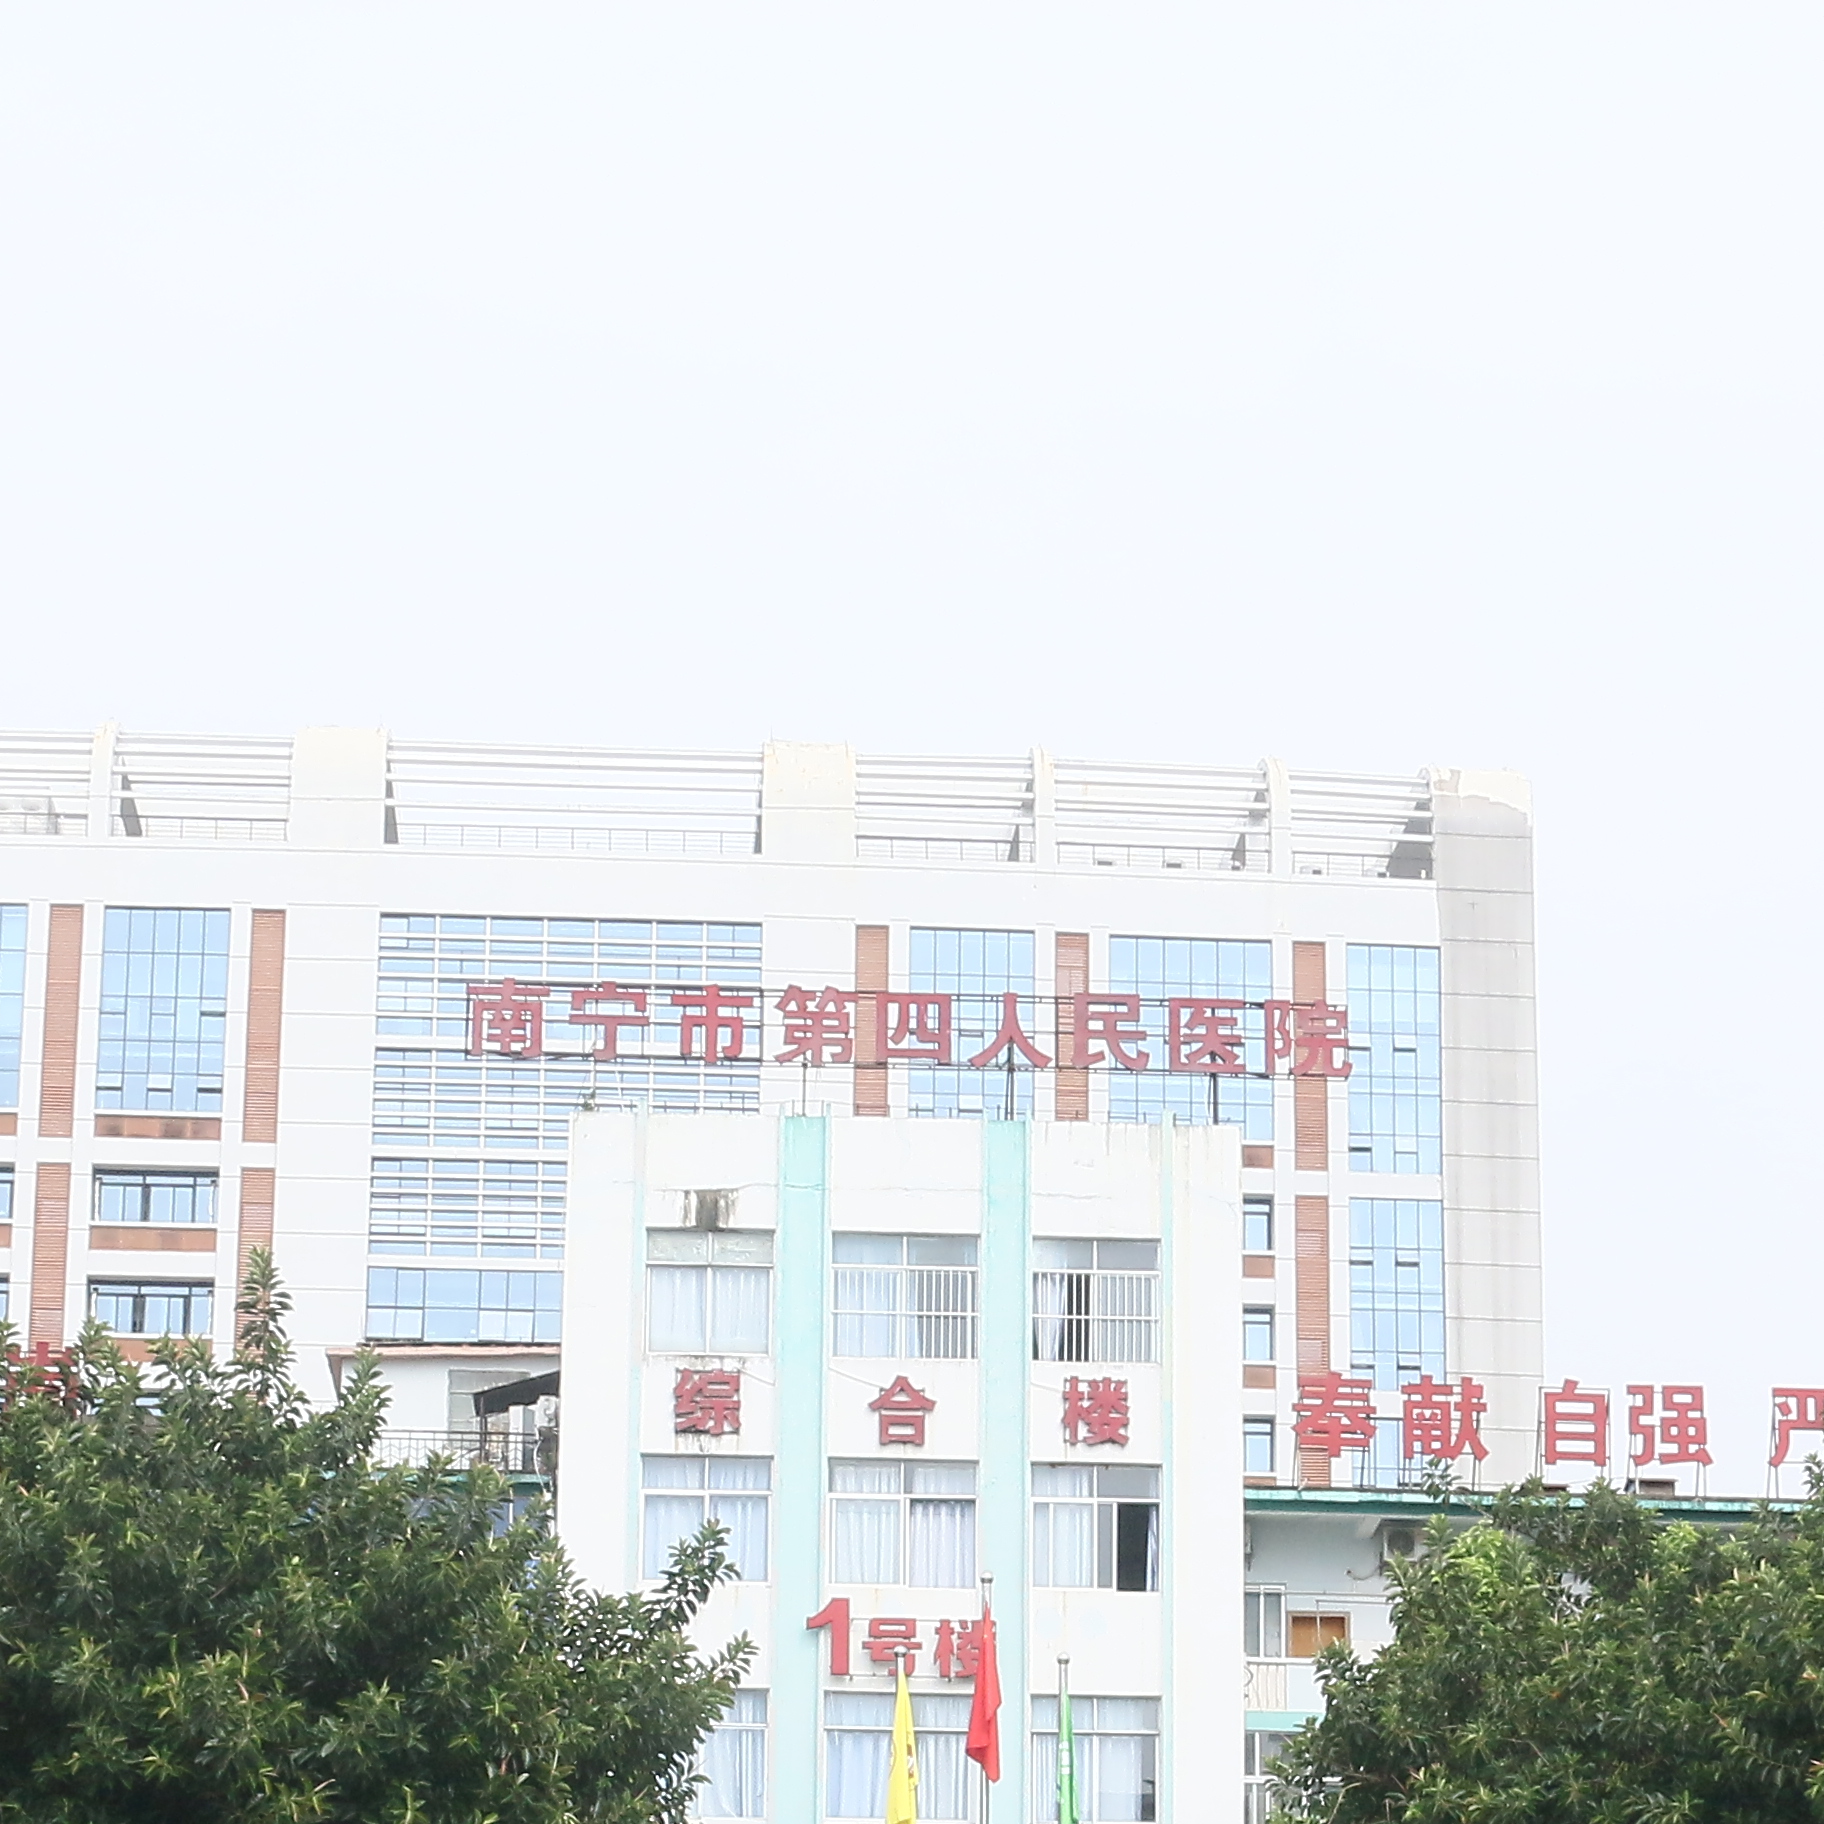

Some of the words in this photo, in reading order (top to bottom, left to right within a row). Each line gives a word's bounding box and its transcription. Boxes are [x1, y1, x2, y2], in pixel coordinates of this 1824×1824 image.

[467, 978, 1353, 1080] 南宁市第四人民医院
[673, 1367, 1131, 1448] 综合楼
[1292, 1372, 1489, 1462] 奉献
[1544, 1380, 1714, 1466] 自强
[806, 1597, 997, 1678] 1号楼
